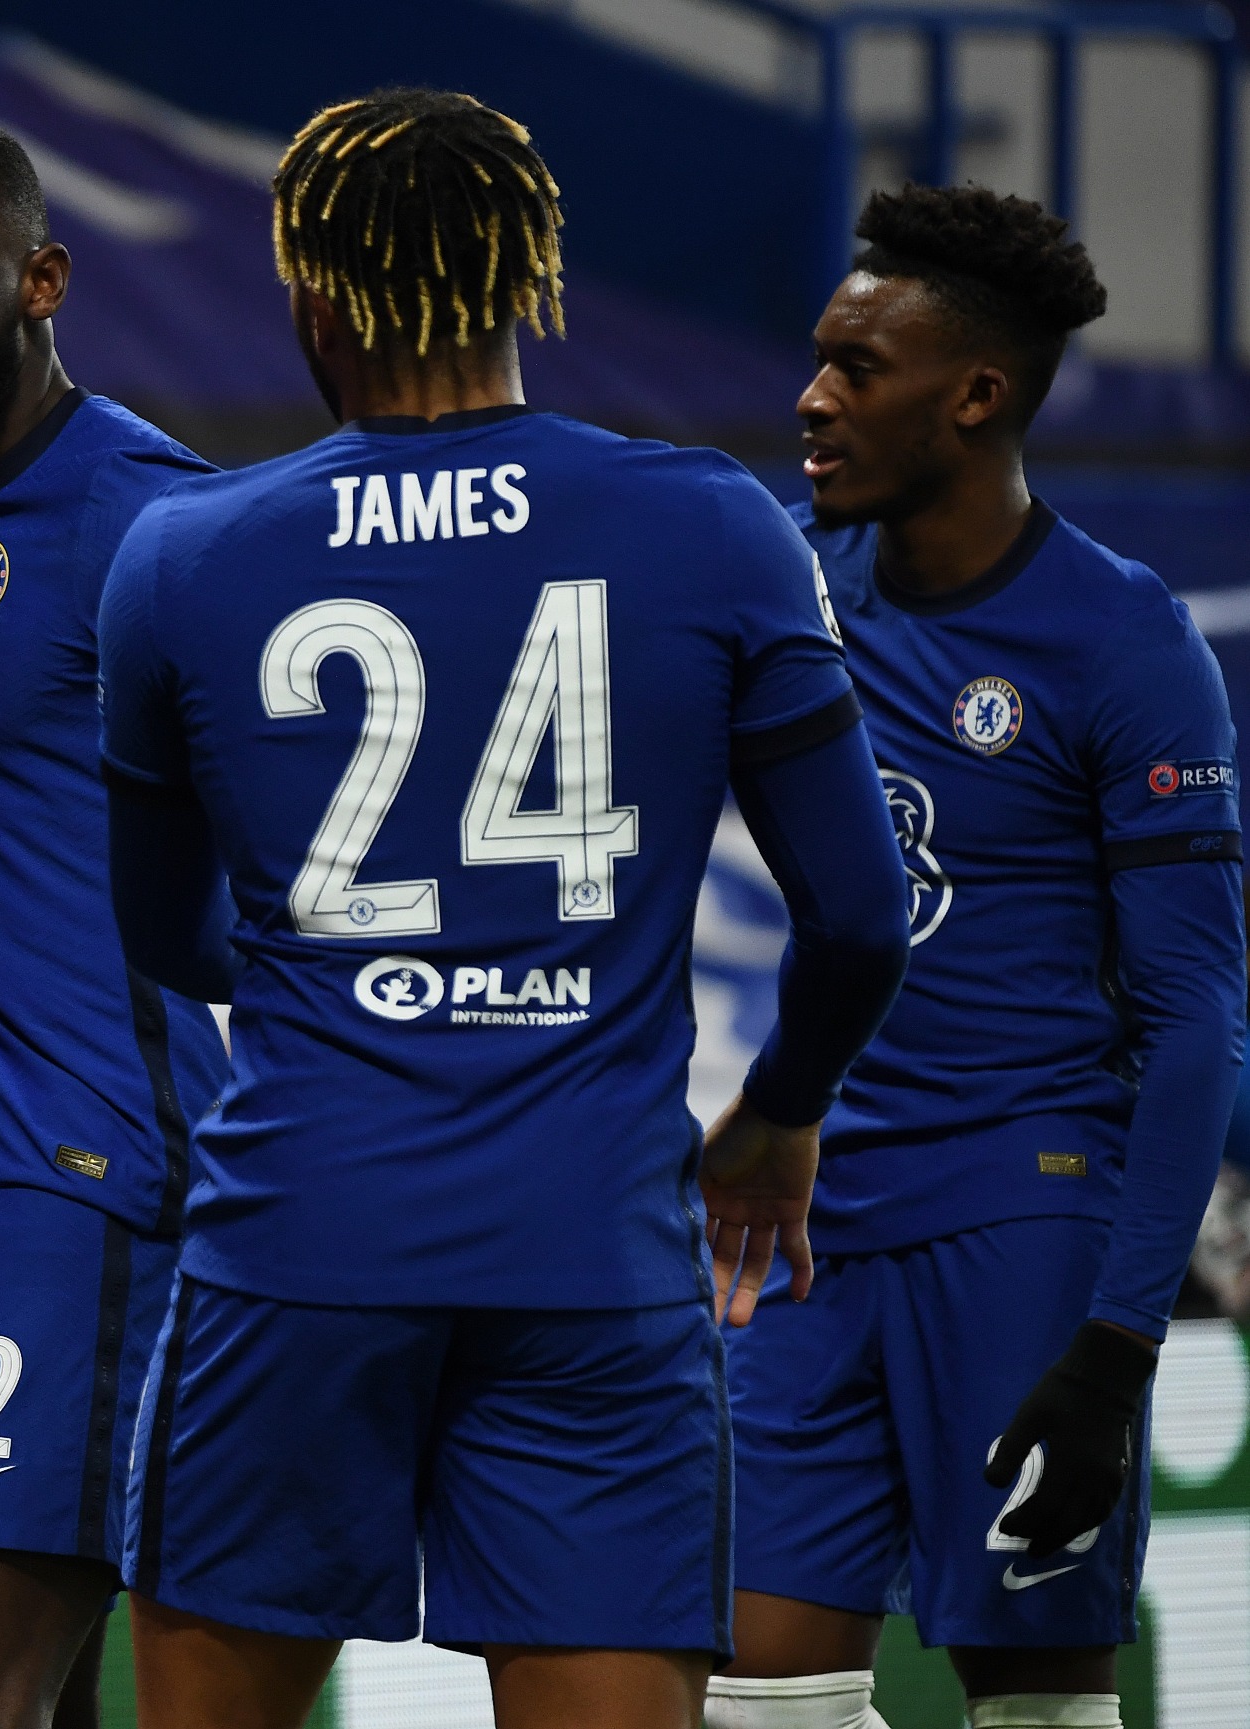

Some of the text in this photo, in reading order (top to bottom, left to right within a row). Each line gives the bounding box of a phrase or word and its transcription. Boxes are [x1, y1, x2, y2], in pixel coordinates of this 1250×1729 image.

[328, 463, 530, 548] JAMES
[970, 680, 1013, 700] CHELSEA
[259, 578, 639, 938] 24
[452, 966, 591, 1006] PLAN
[451, 1009, 591, 1027] INTERNATIONAL
[986, 1435, 1101, 1553] 2
